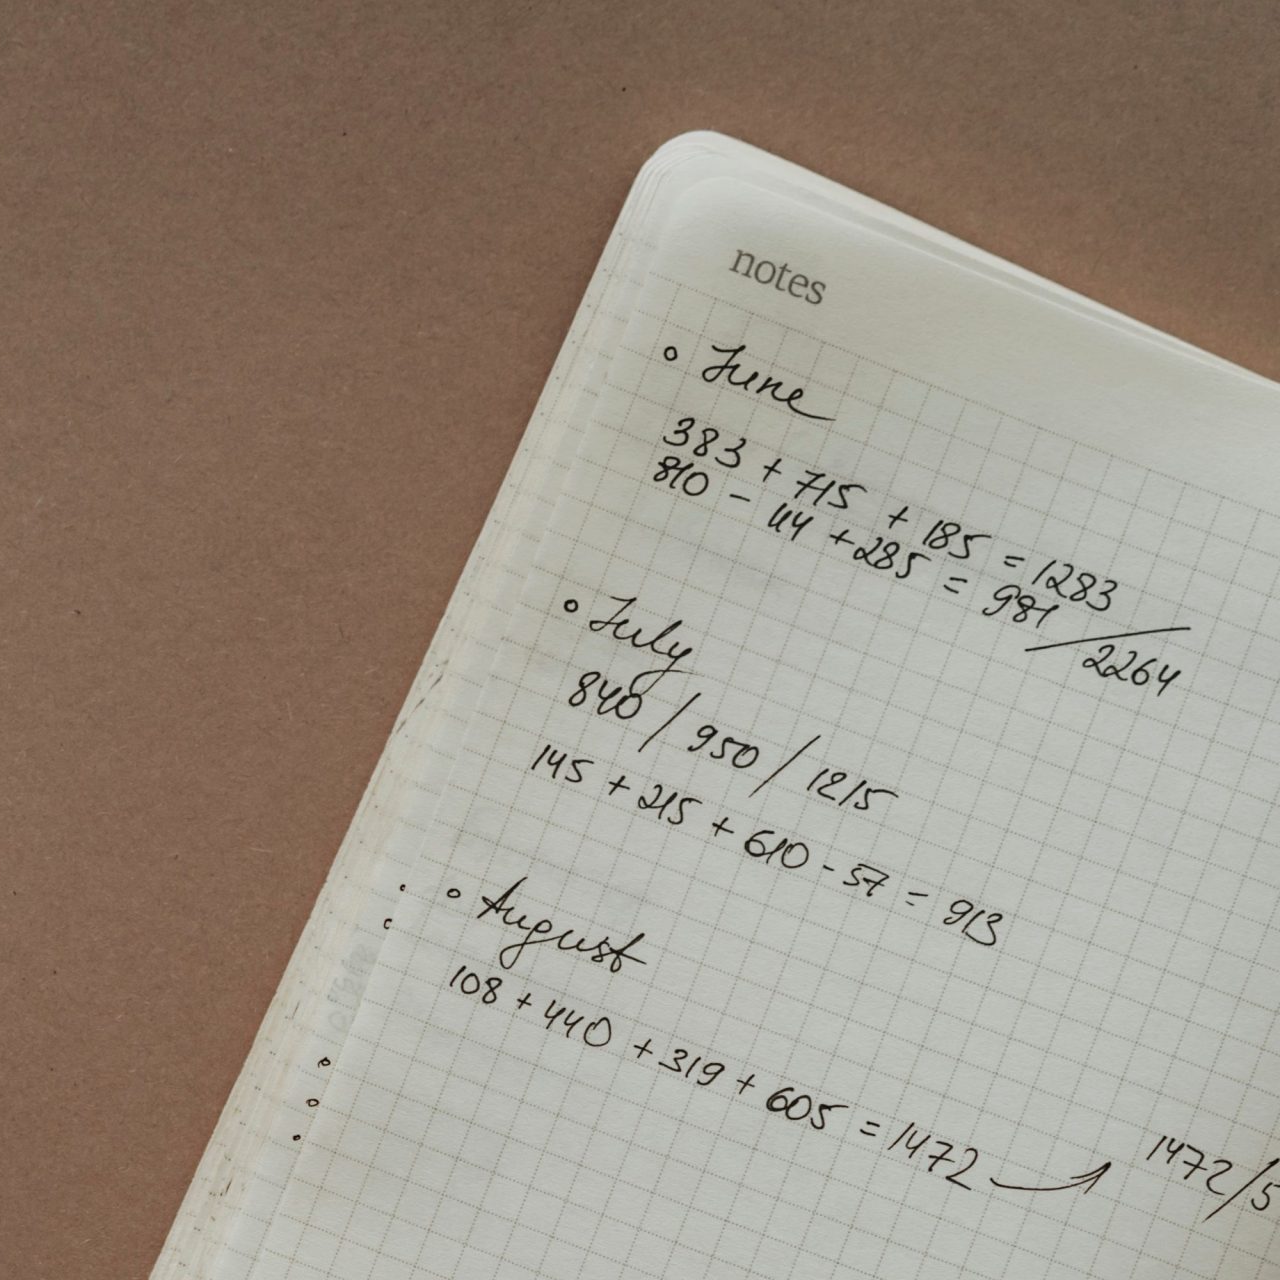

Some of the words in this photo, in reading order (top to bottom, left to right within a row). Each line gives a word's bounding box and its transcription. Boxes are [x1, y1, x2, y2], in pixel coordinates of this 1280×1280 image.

[730, 245, 828, 306] notes
[702, 344, 835, 421] June
[653, 456, 709, 497] 810
[853, 537, 932, 579] 285
[983, 585, 1060, 628] 981
[663, 417, 747, 468] 383
[794, 470, 868, 509] 715
[923, 519, 992, 560] 185
[1031, 559, 1118, 612] 1283
[589, 596, 702, 697] July
[1082, 644, 1181, 696] 2264
[568, 671, 643, 720] 840
[687, 725, 760, 768] 950
[806, 768, 899, 810] 1215
[531, 744, 594, 783] 145
[637, 784, 703, 825] 215
[744, 829, 809, 869] 610
[842, 863, 890, 897] 57
[943, 899, 1003, 946] 913
[477, 877, 647, 973] August
[449, 965, 503, 1005] 108
[544, 999, 612, 1047] 440
[658, 1048, 725, 1086] 319
[766, 1087, 849, 1130] 605
[888, 1122, 978, 1191] 1472
